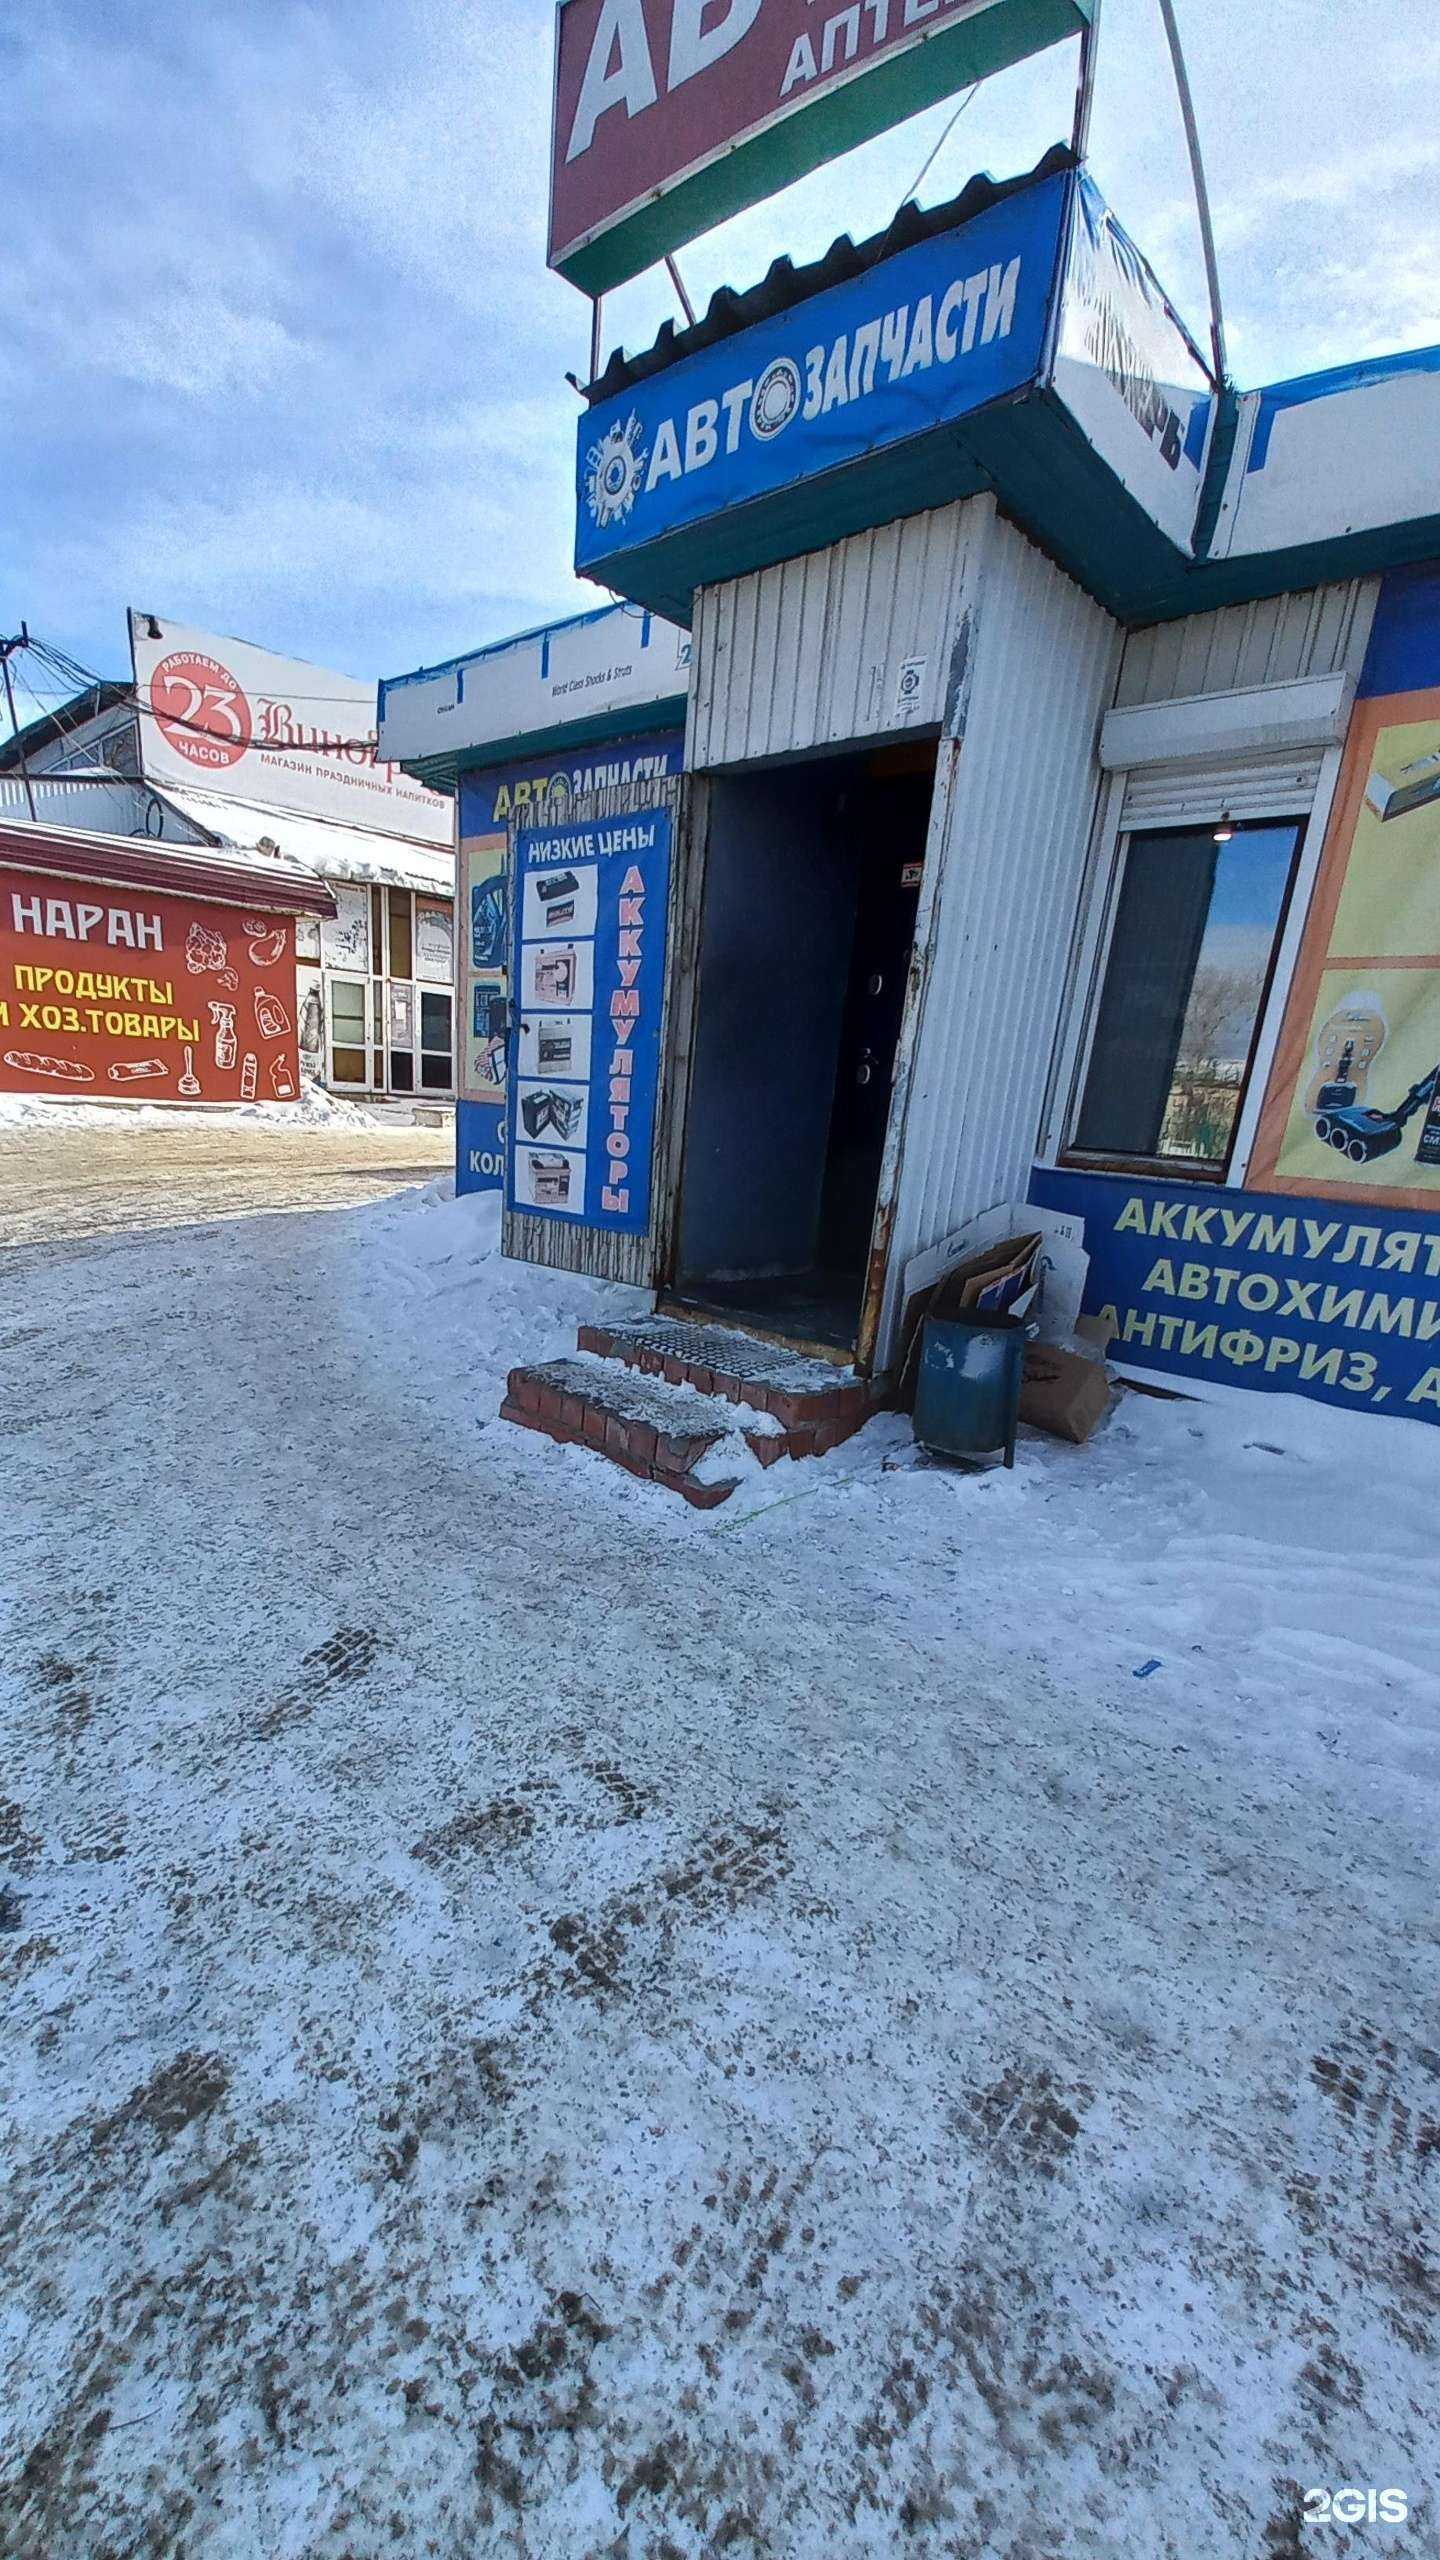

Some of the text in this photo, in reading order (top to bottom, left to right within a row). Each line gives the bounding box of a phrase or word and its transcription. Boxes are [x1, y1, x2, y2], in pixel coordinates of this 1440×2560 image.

[162, 653, 238, 690] РАБОТАЕМ ДО
[163, 675, 242, 748] 23
[179, 740, 231, 764] ЧАСОВ
[260, 753, 446, 810] МАГАЗИН ПРАЗДНИЧНЫХ НАПИТКОВ
[528, 824, 655, 864] НИЗКИЕ ЦЕНЫ
[11, 893, 164, 952] НАРАН
[14, 964, 174, 1006] ПРОДУКТЫ
[602, 865, 646, 1213] АККУМУЛЯТОРЫ
